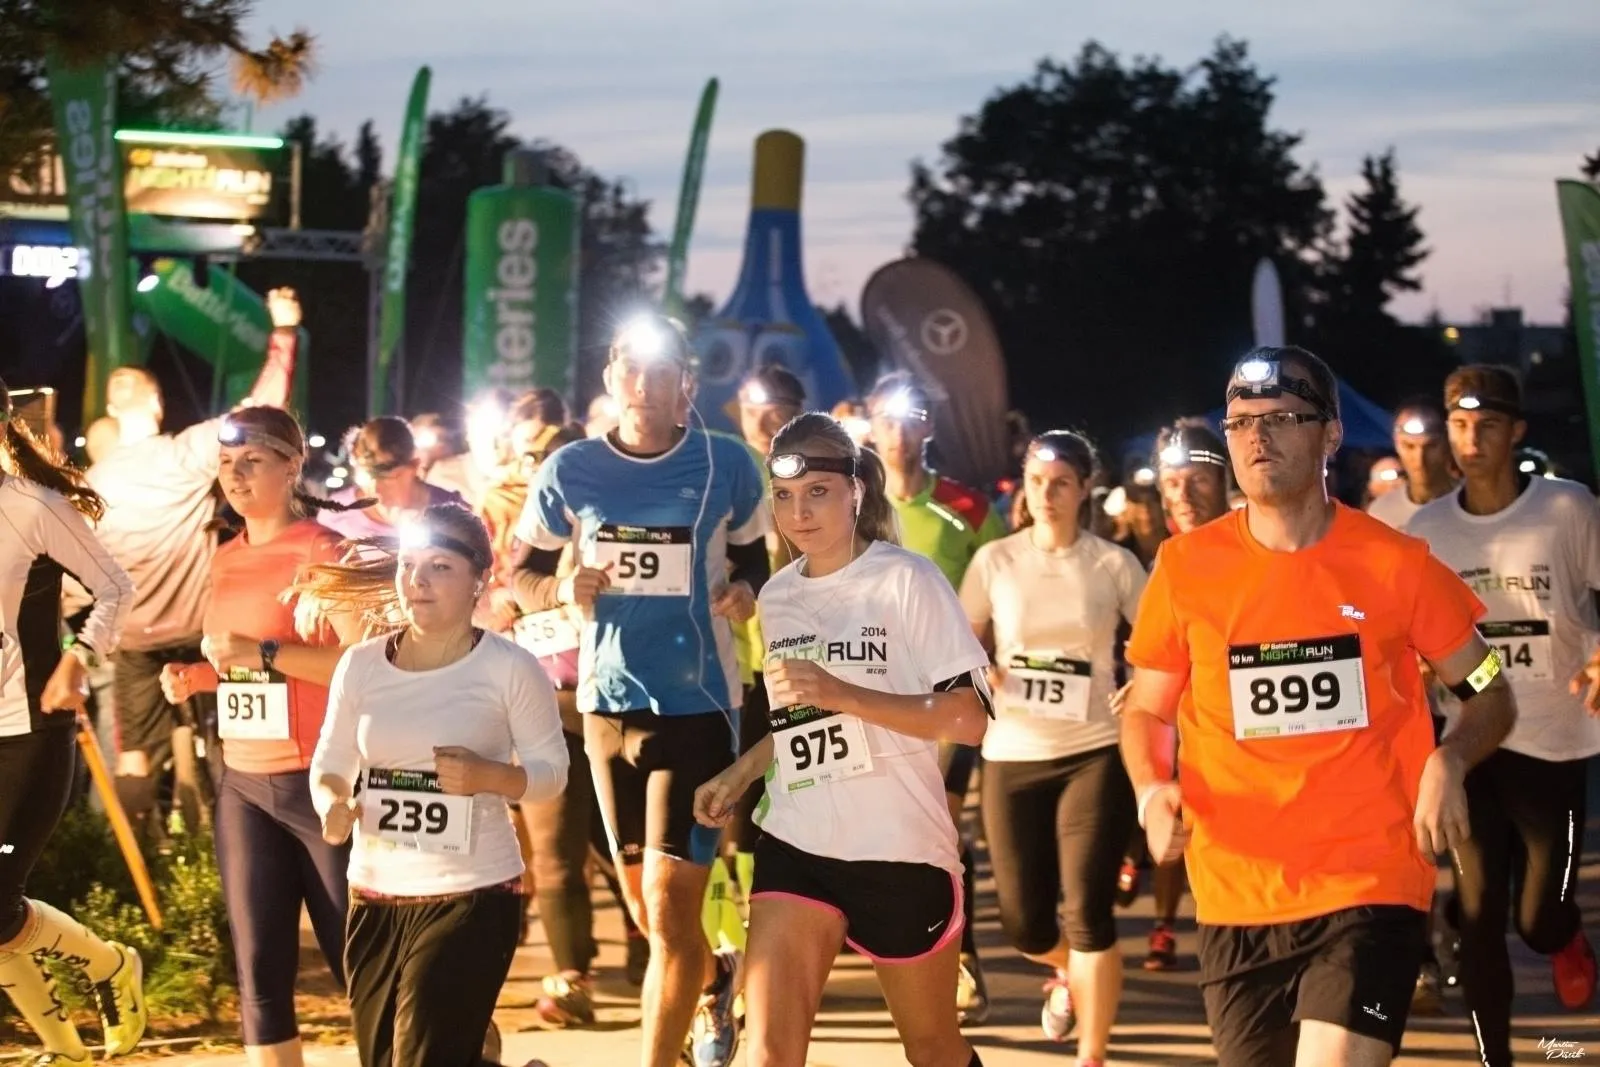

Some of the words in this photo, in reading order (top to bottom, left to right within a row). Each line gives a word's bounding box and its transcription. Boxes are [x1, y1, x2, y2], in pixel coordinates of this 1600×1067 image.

[487, 219, 538, 388] teries
[618, 551, 659, 580] 59
[1505, 575, 1551, 591] RUN
[768, 633, 817, 653] Batteries
[861, 626, 887, 638] 2014
[828, 641, 887, 662] RUN
[1260, 648, 1298, 662] NIGHT
[1305, 645, 1333, 658] RUN
[1489, 642, 1533, 669] 14
[1022, 678, 1065, 704] 113
[1250, 671, 1341, 716] 899
[227, 692, 267, 720] 931
[789, 707, 815, 721] NIGHT
[789, 723, 849, 771] 975
[378, 798, 449, 835] 239
